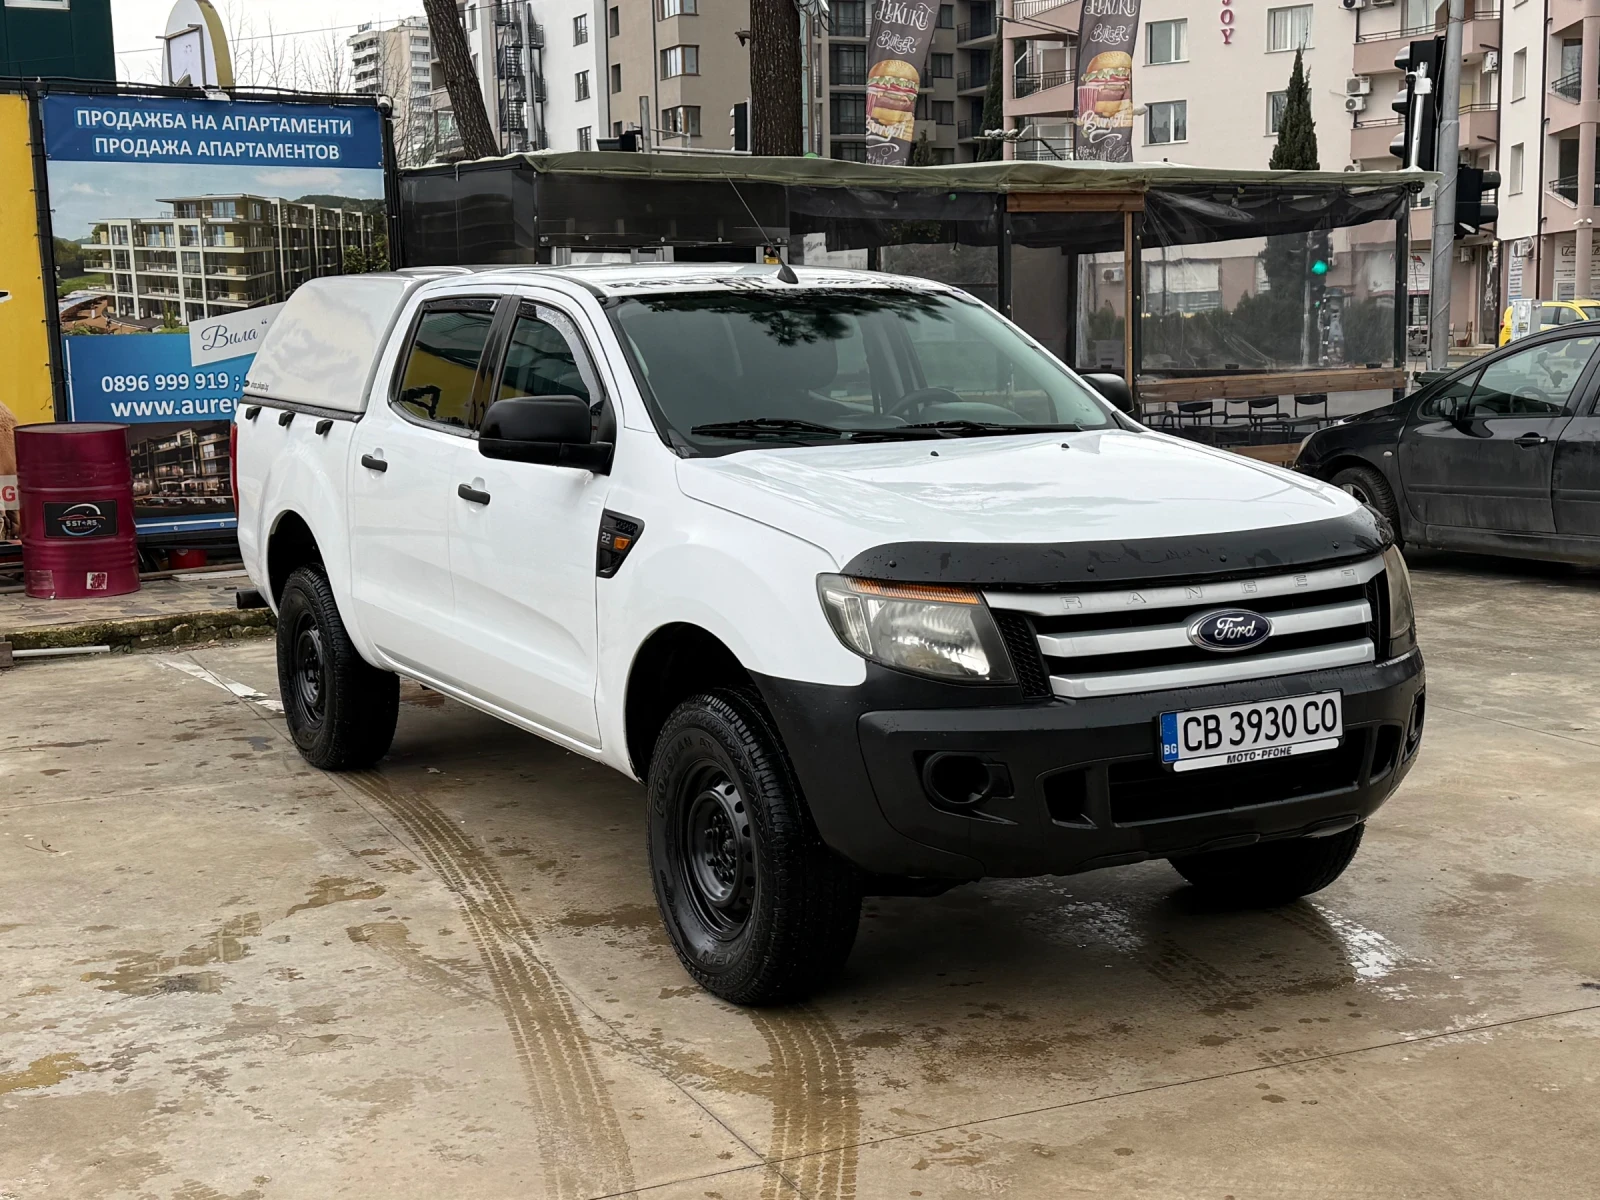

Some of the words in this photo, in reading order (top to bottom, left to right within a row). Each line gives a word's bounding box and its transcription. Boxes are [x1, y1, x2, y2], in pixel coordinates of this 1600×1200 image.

[77, 110, 187, 130] ПРОДАЖБА
[191, 114, 218, 130] НА
[222, 115, 352, 135] АПАРТАМЕНТИ
[95, 137, 193, 158] ПРОДАЖА
[197, 140, 340, 160] АПАРТАМЕНТОВ
[200, 324, 259, 351] Вила
[101, 374, 150, 393] 0896
[154, 373, 190, 391] 999
[195, 372, 230, 390] 919
[1060, 568, 1356, 610] RANGER
[1214, 616, 1256, 640] Ford
[1183, 714, 1223, 751] CB
[1229, 704, 1297, 746] 3930
[1163, 743, 1177, 755] BG
[1226, 746, 1293, 764] MOTO-PFOHE
